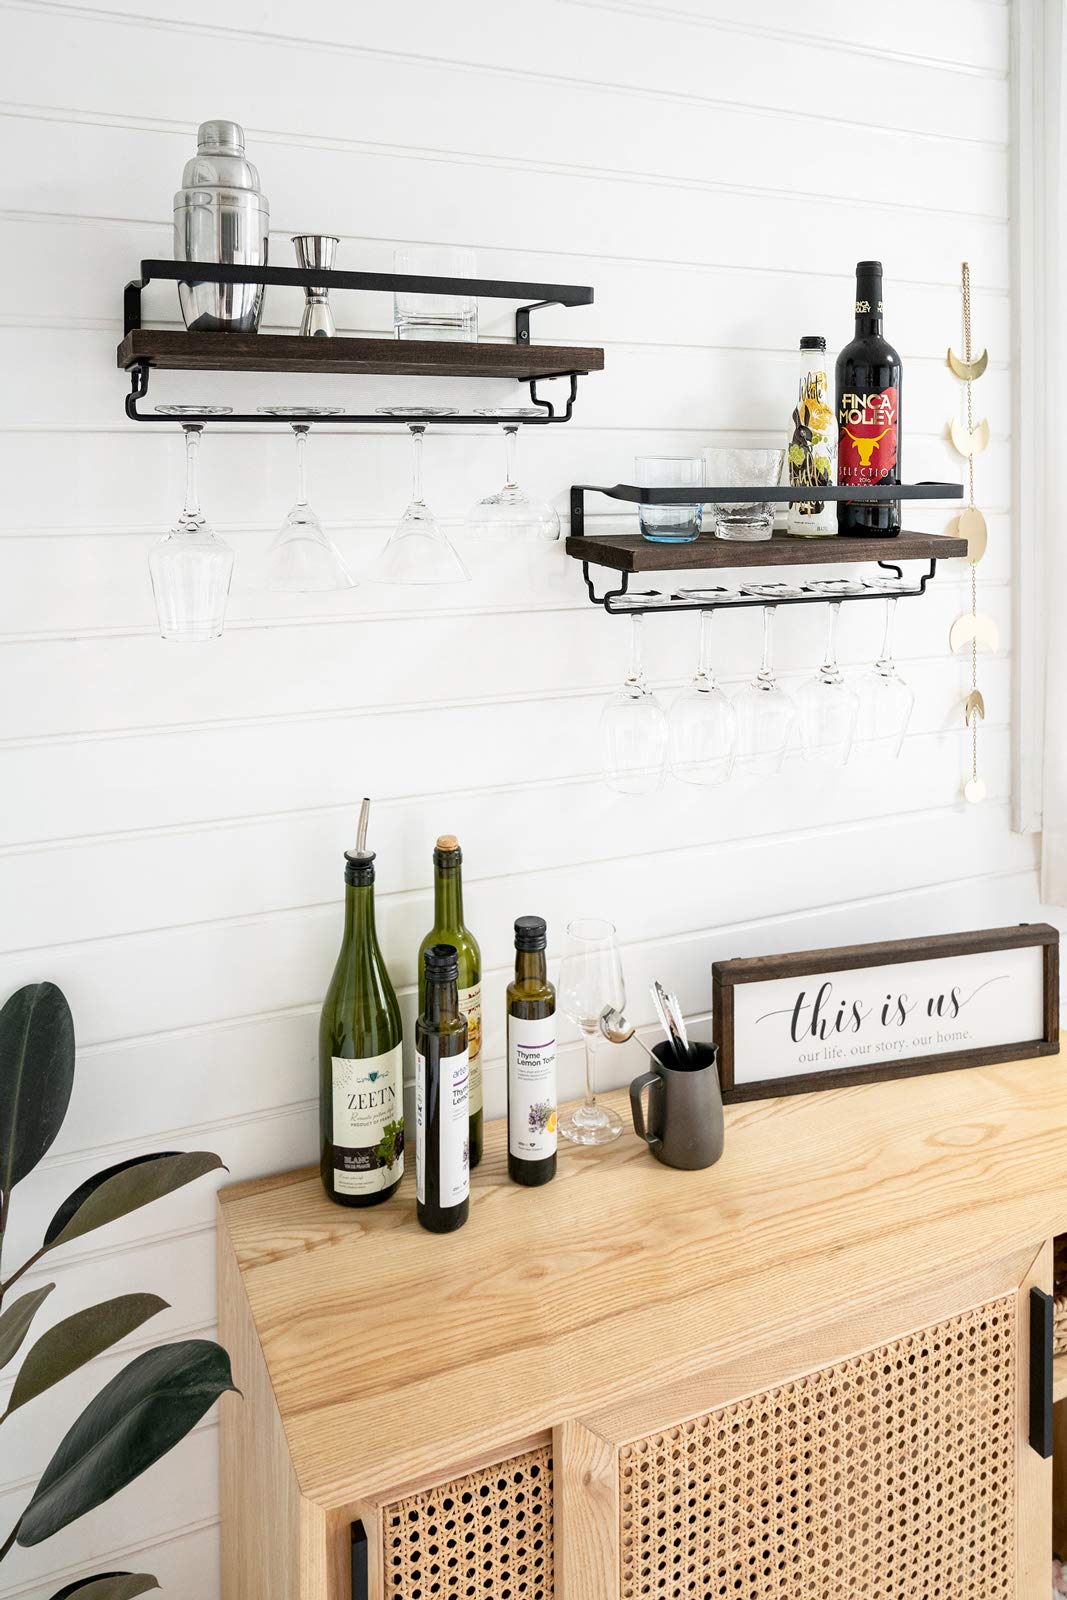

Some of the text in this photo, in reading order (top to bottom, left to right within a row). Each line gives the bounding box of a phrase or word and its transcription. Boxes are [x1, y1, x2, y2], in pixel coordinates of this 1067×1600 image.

[841, 393, 892, 410] FINCA
[839, 409, 895, 426] MOLEY
[756, 975, 1010, 1043] this is us
[517, 1050, 541, 1060] Thyme
[798, 1029, 973, 1064] our life. our story. our home.
[517, 1058, 541, 1067] Lemon
[344, 1156, 370, 1164] BLANC
